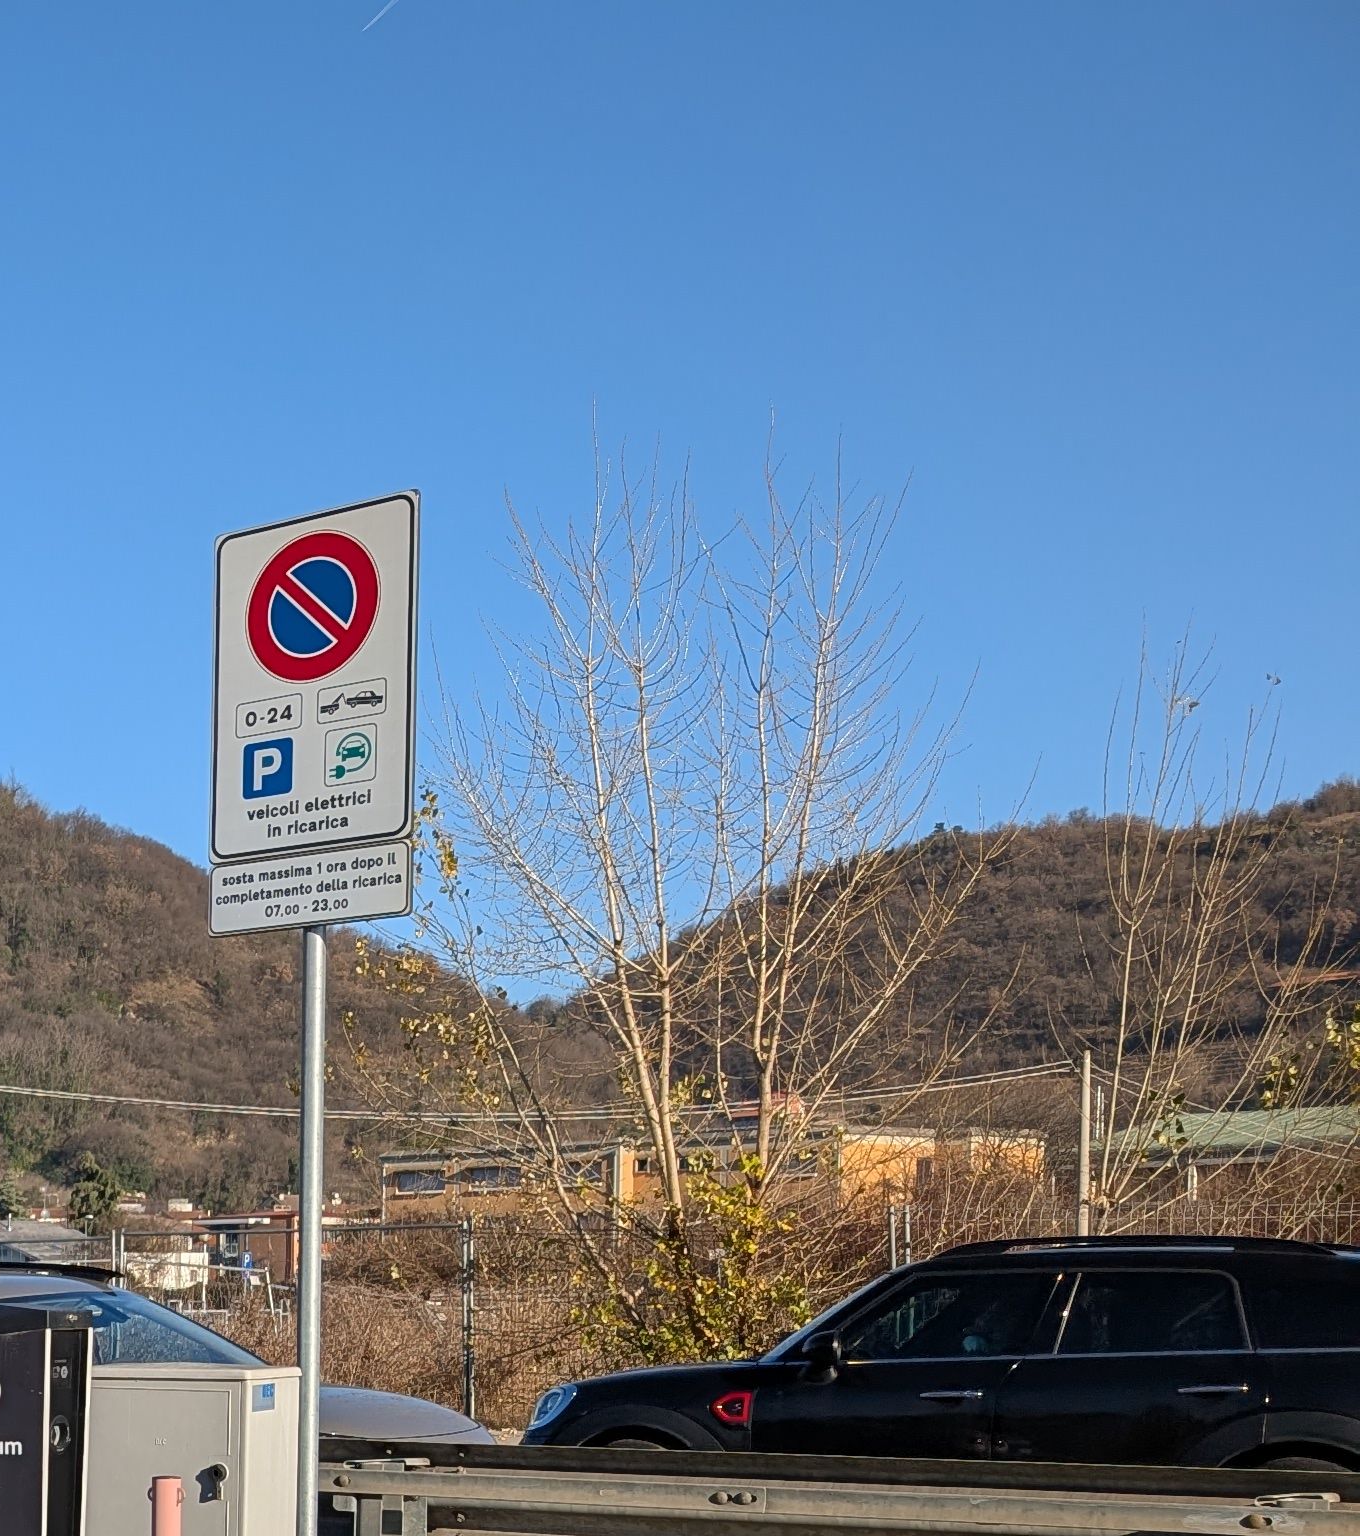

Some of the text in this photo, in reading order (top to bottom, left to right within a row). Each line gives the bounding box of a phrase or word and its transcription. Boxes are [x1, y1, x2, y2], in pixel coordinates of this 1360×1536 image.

[245, 704, 293, 727] 0-24
[253, 747, 282, 791] P
[247, 788, 372, 821] veicoli elettrici
[267, 815, 349, 838] in ricarica
[222, 852, 397, 887] sosta massima 1 ora dopo il
[215, 872, 402, 907] completamento della ricarica
